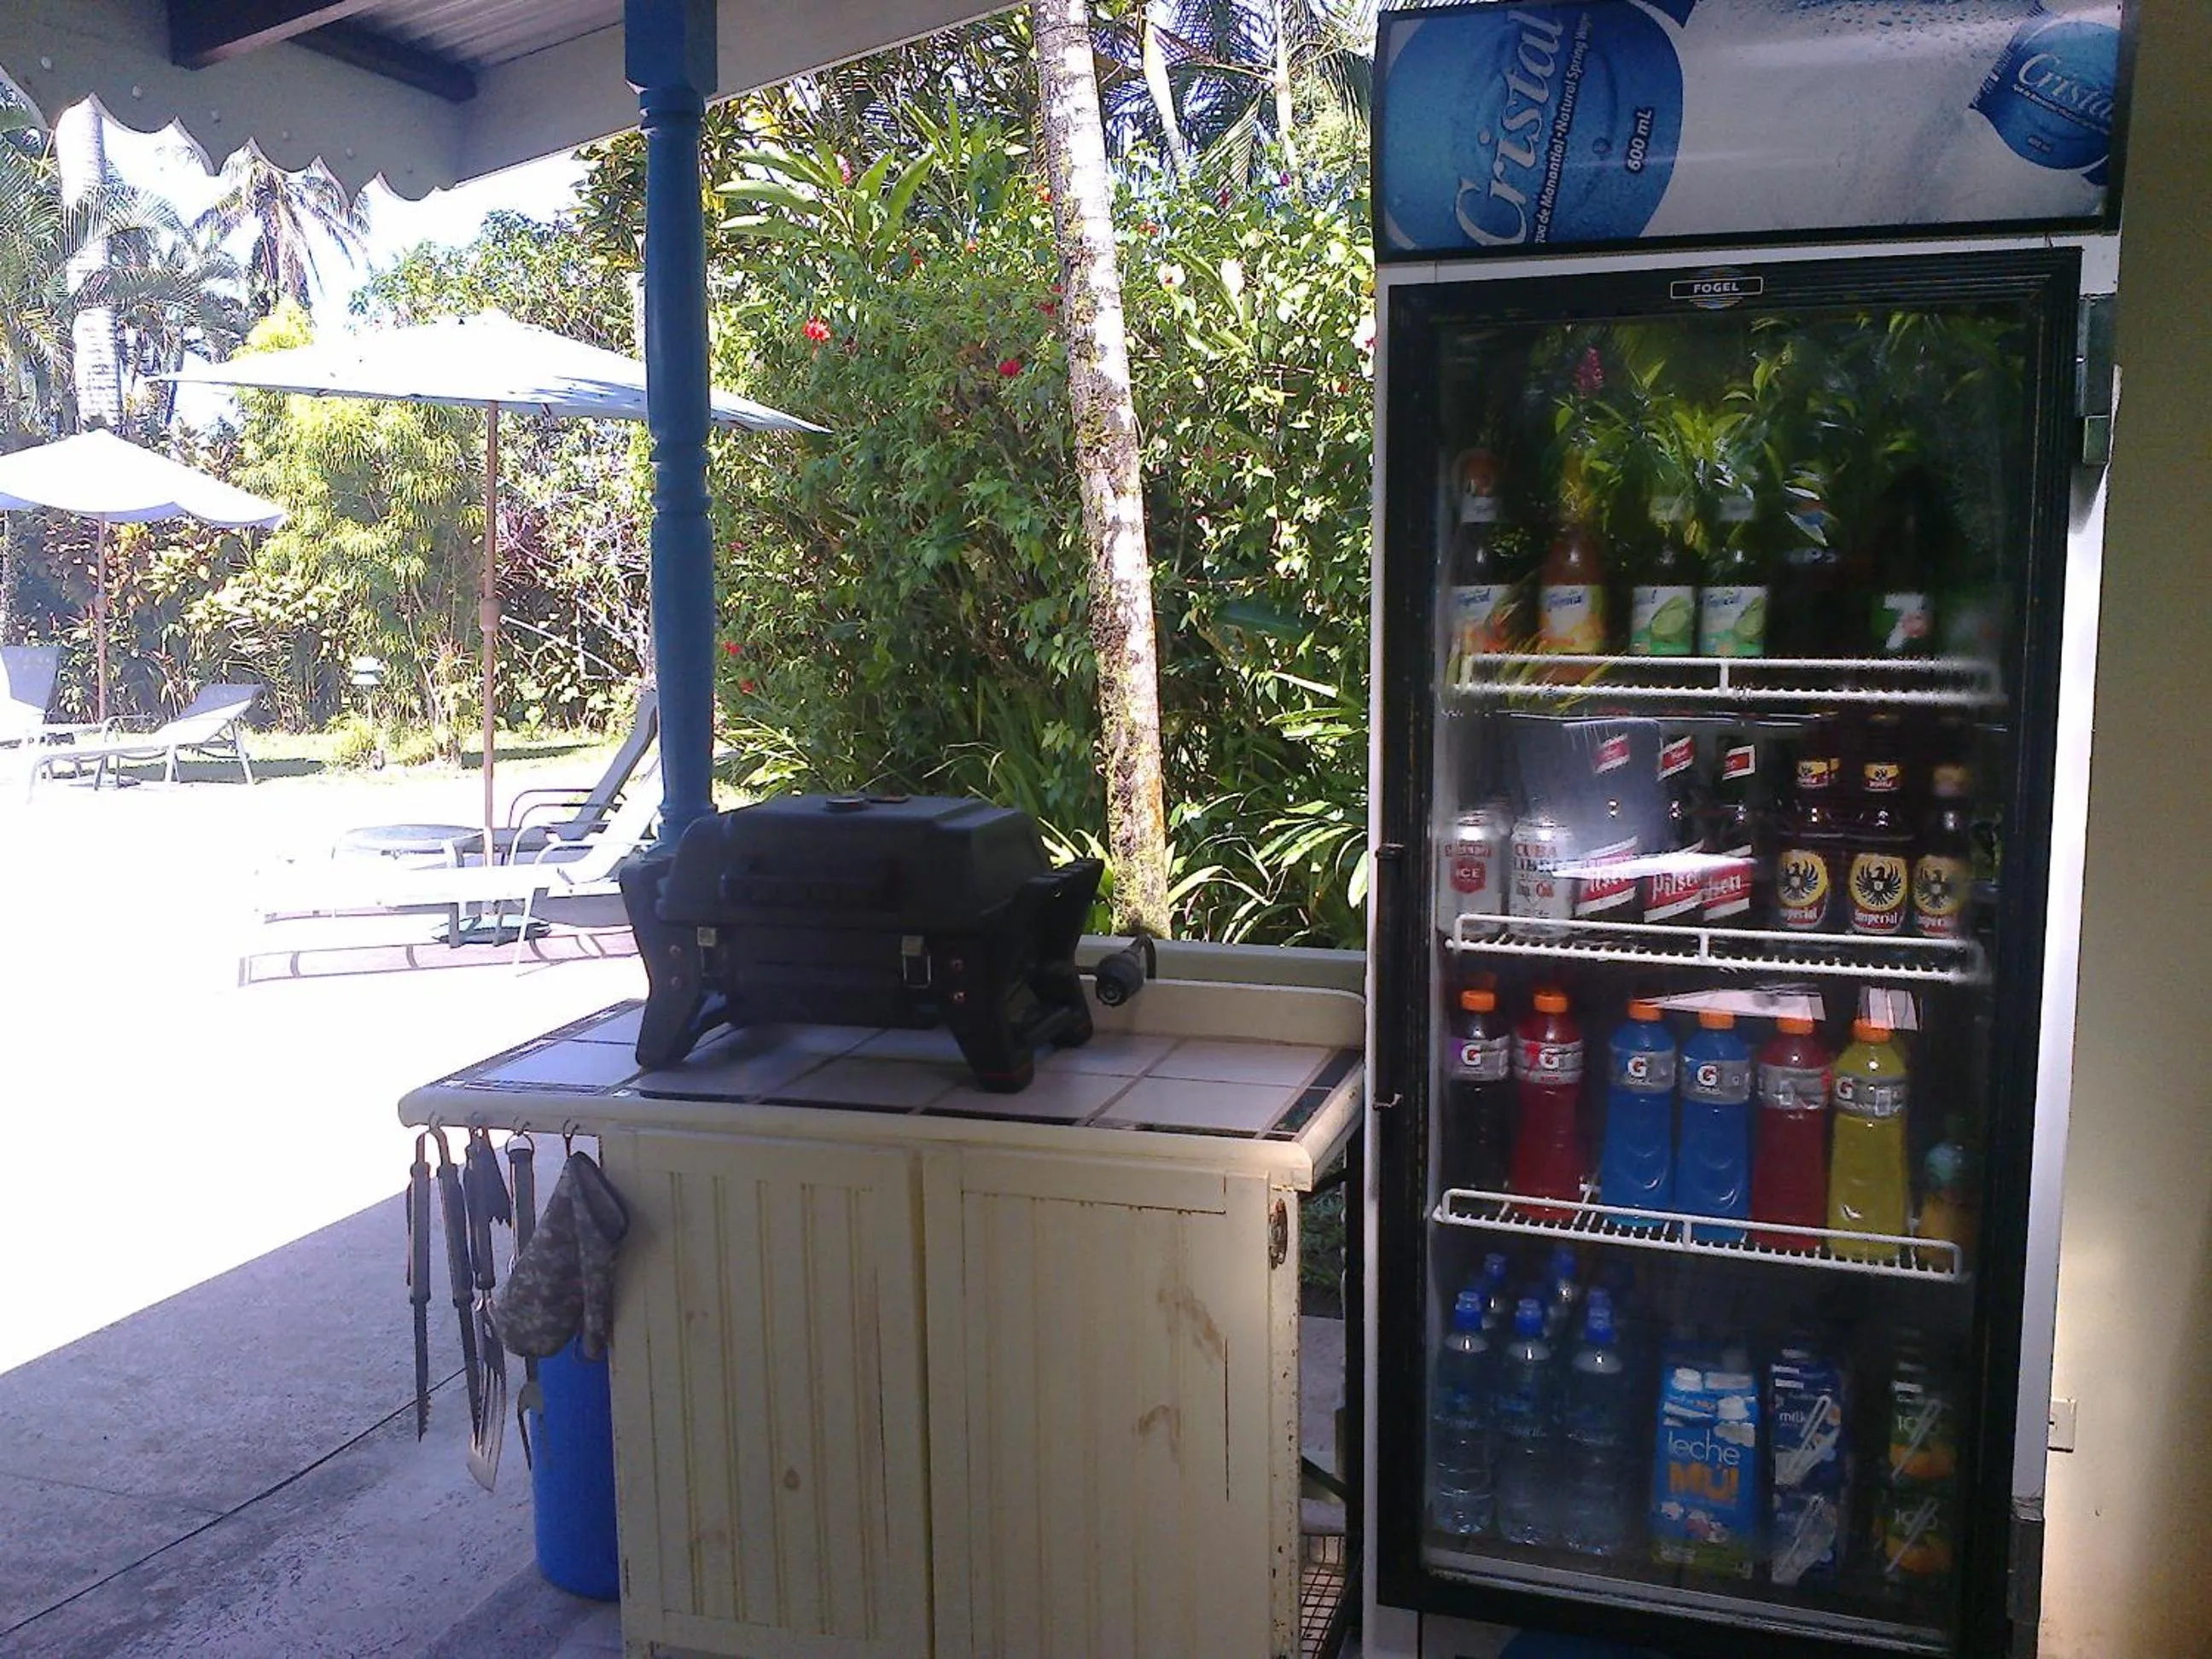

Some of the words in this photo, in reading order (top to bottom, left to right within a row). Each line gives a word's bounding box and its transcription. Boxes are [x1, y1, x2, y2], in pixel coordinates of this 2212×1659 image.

[1455, 9, 1564, 247] Cristal
[1554, 79, 1576, 132] Natural
[1627, 138, 1645, 172] 600
[1636, 110, 1652, 137] mL
[1539, 138, 1564, 207] Manantial
[1536, 208, 1551, 224] de
[1693, 282, 1740, 294] FOGEL
[1668, 1430, 1741, 1465] leche
